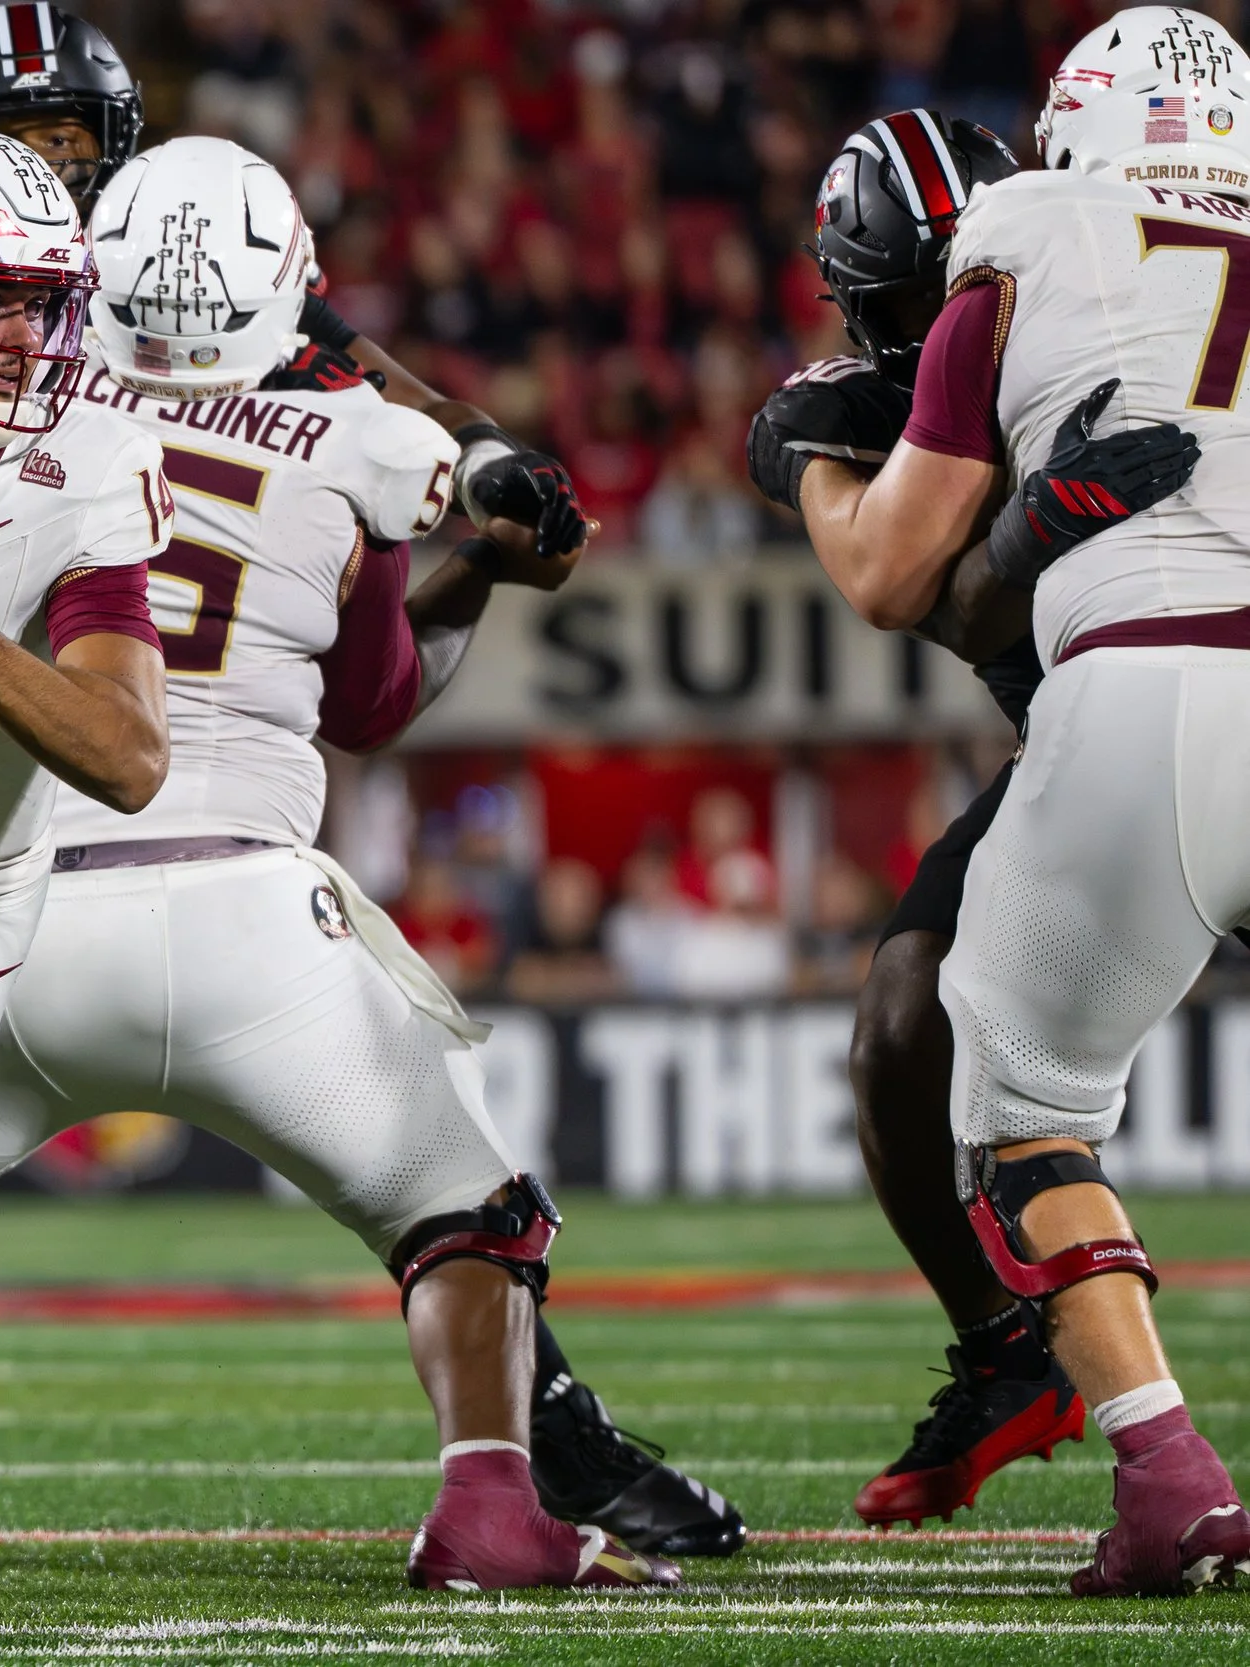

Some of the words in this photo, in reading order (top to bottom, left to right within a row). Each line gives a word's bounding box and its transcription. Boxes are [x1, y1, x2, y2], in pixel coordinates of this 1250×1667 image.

[11, 73, 52, 89] ACC
[1124, 164, 1199, 182] FLORIDA
[1206, 166, 1249, 188] STATE
[37, 247, 72, 263] ACC
[121, 375, 187, 400] FLORIDA
[193, 380, 244, 399] STATE
[21, 471, 63, 487] insurance
[132, 465, 175, 548] 14
[579, 1010, 856, 1198] THE
